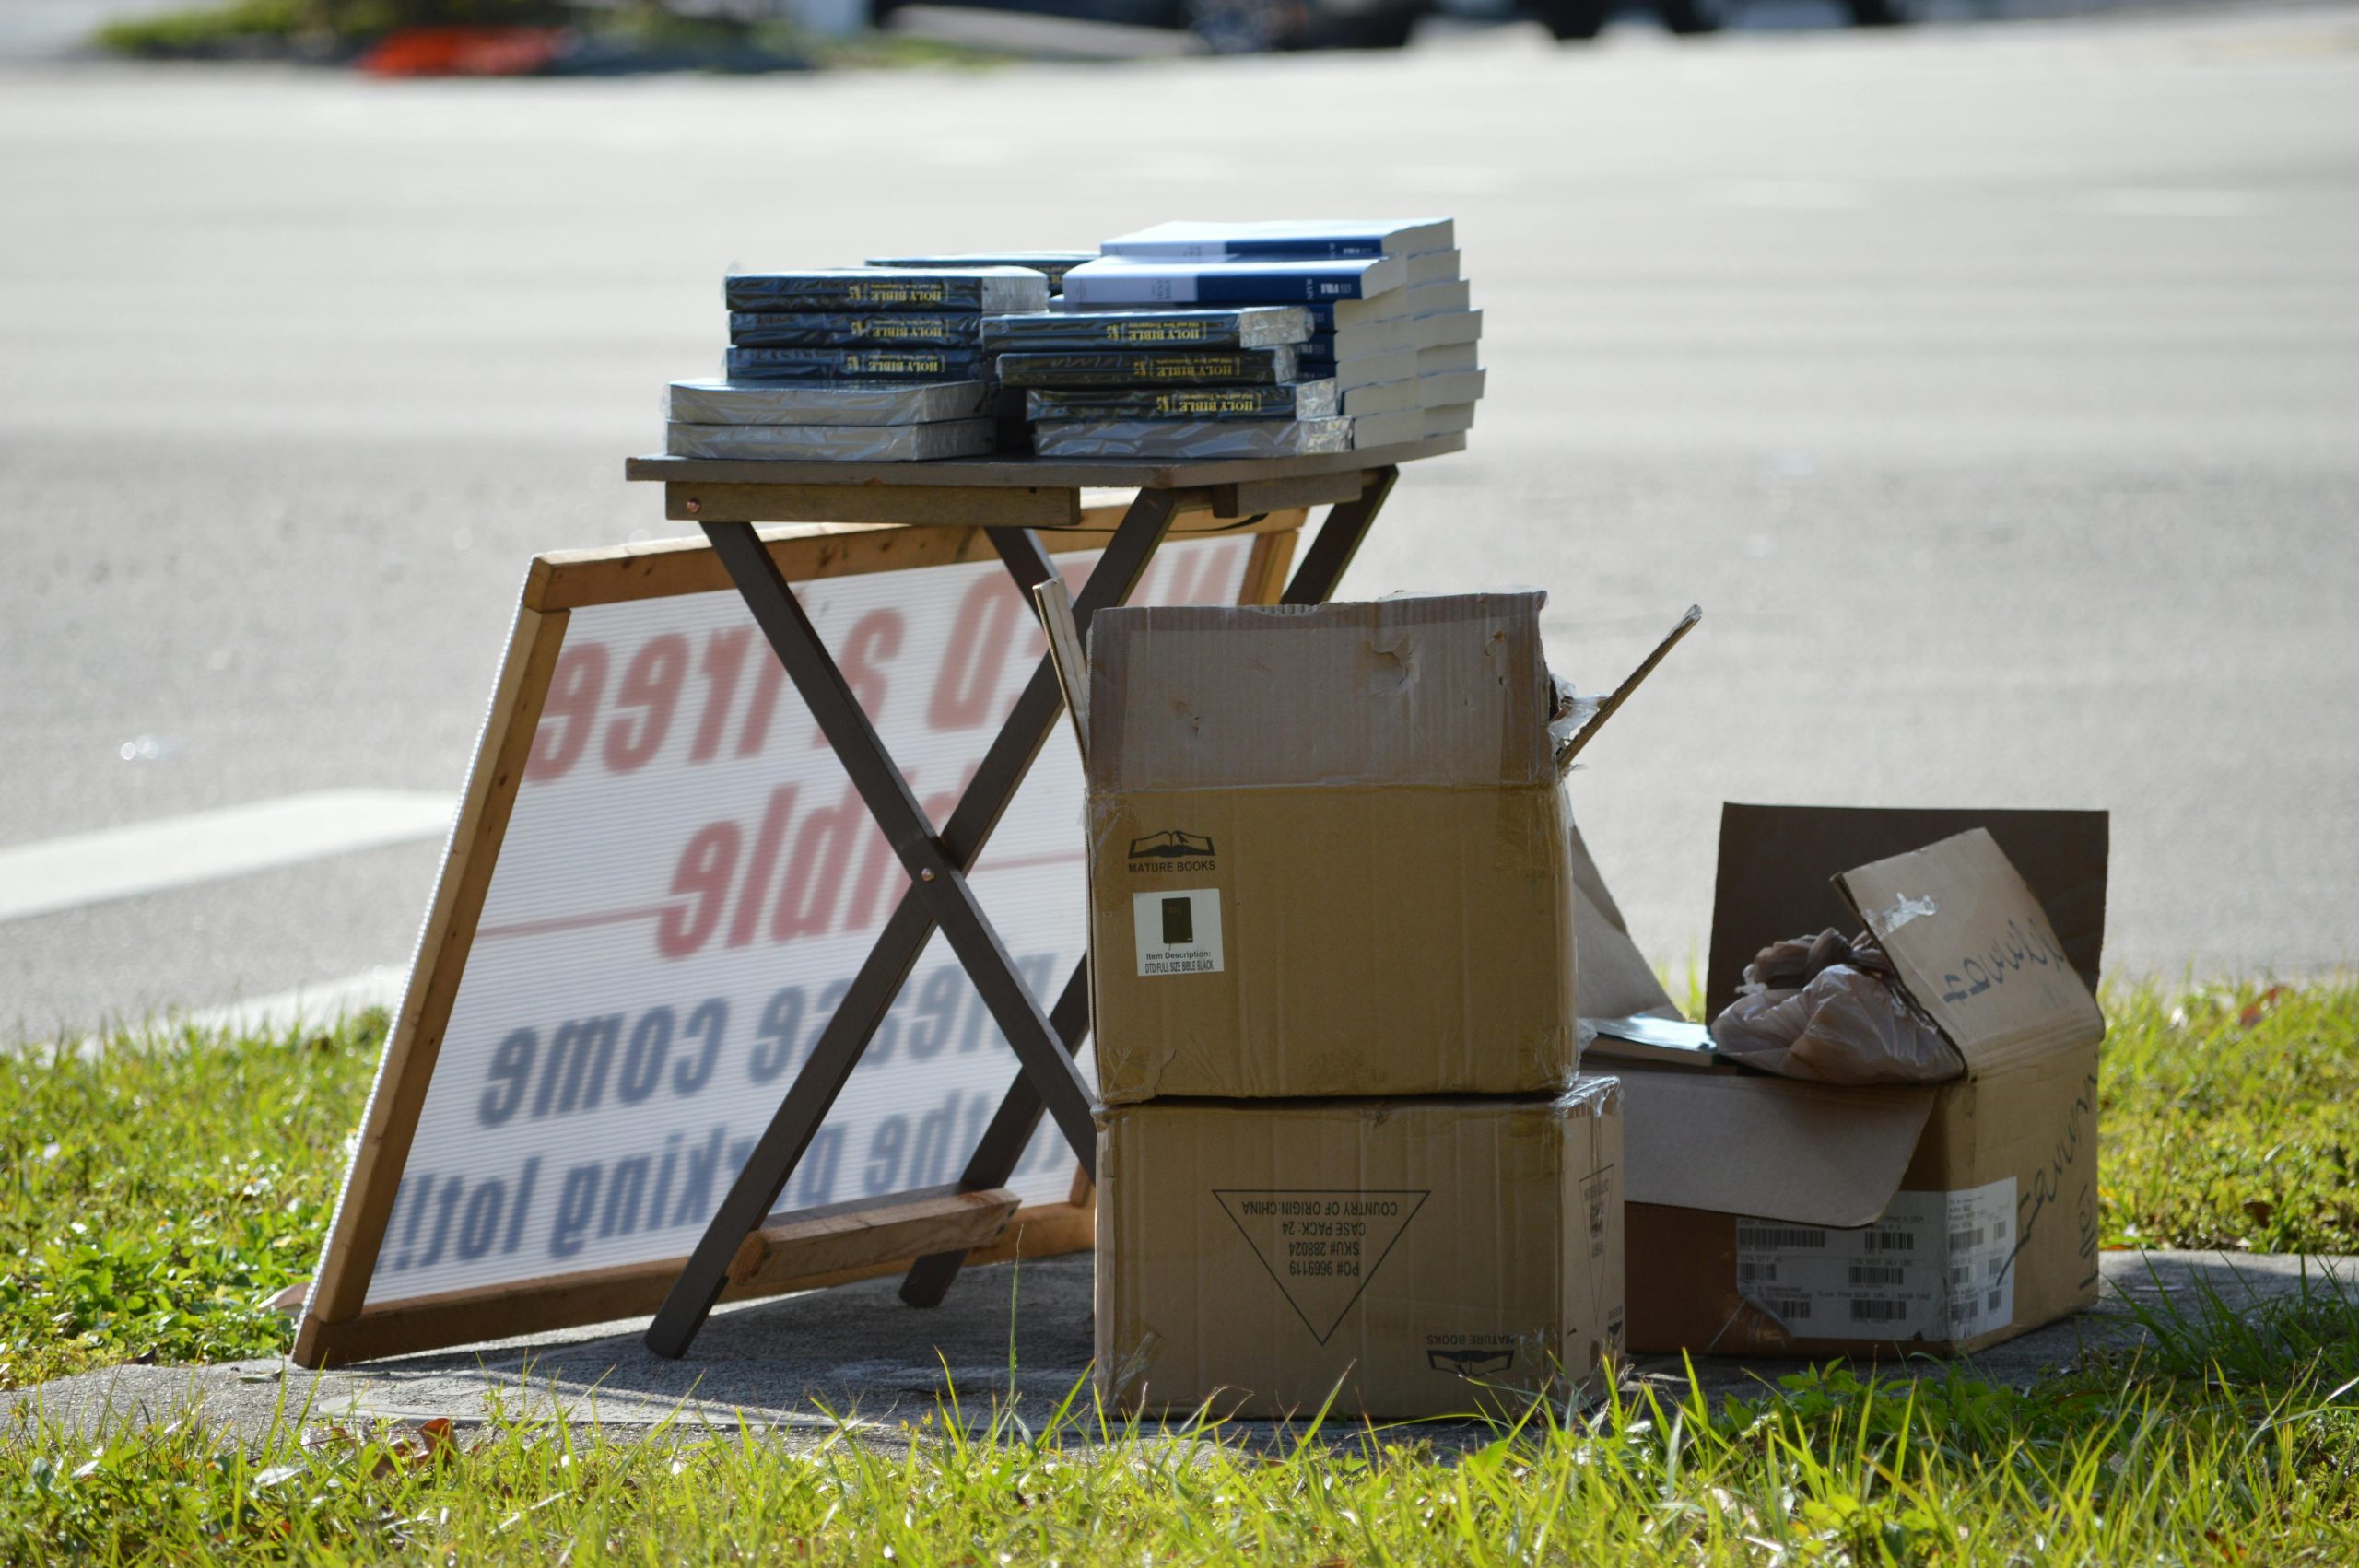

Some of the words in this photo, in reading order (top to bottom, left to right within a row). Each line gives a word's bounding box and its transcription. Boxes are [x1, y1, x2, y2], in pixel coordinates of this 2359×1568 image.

[871, 290, 907, 302] BIBLE
[909, 290, 942, 302] HOLY
[872, 327, 908, 337] BIBLE
[911, 327, 943, 337] HOLY
[1128, 330, 1165, 341] BIBLE
[1167, 329, 1200, 340] HOLY
[868, 361, 904, 372] BIBLE
[907, 361, 938, 372] HOLY
[1157, 366, 1195, 377] BIBLE
[1198, 365, 1232, 376] HOLY
[1179, 402, 1217, 413] BIBLE
[1220, 401, 1254, 412] HOLY
[1128, 862, 1173, 873] MATURE
[1177, 860, 1215, 872] BOOKS
[1165, 951, 1211, 959] Description:
[1145, 963, 1156, 973] DTD
[1156, 962, 1168, 973] FULL
[1170, 961, 1181, 972] SIZE
[1182, 961, 1195, 971] BIBLE
[1197, 960, 1214, 970] BLACK
[1242, 1201, 1320, 1216] ORIGIN:CHINA
[1325, 1201, 1340, 1216] OF
[1343, 1201, 1398, 1216] COUNTRY
[1282, 1222, 1294, 1235] 24
[1298, 1222, 1332, 1236] PACK:
[1335, 1222, 1366, 1236] CASE
[1289, 1242, 1326, 1256] 288024
[1330, 1242, 1360, 1256] SKU#
[1290, 1261, 1332, 1276] 9669119
[1337, 1261, 1359, 1276] PO#
[1426, 1334, 1466, 1345] BOOKS
[1470, 1334, 1515, 1345] MATURE
